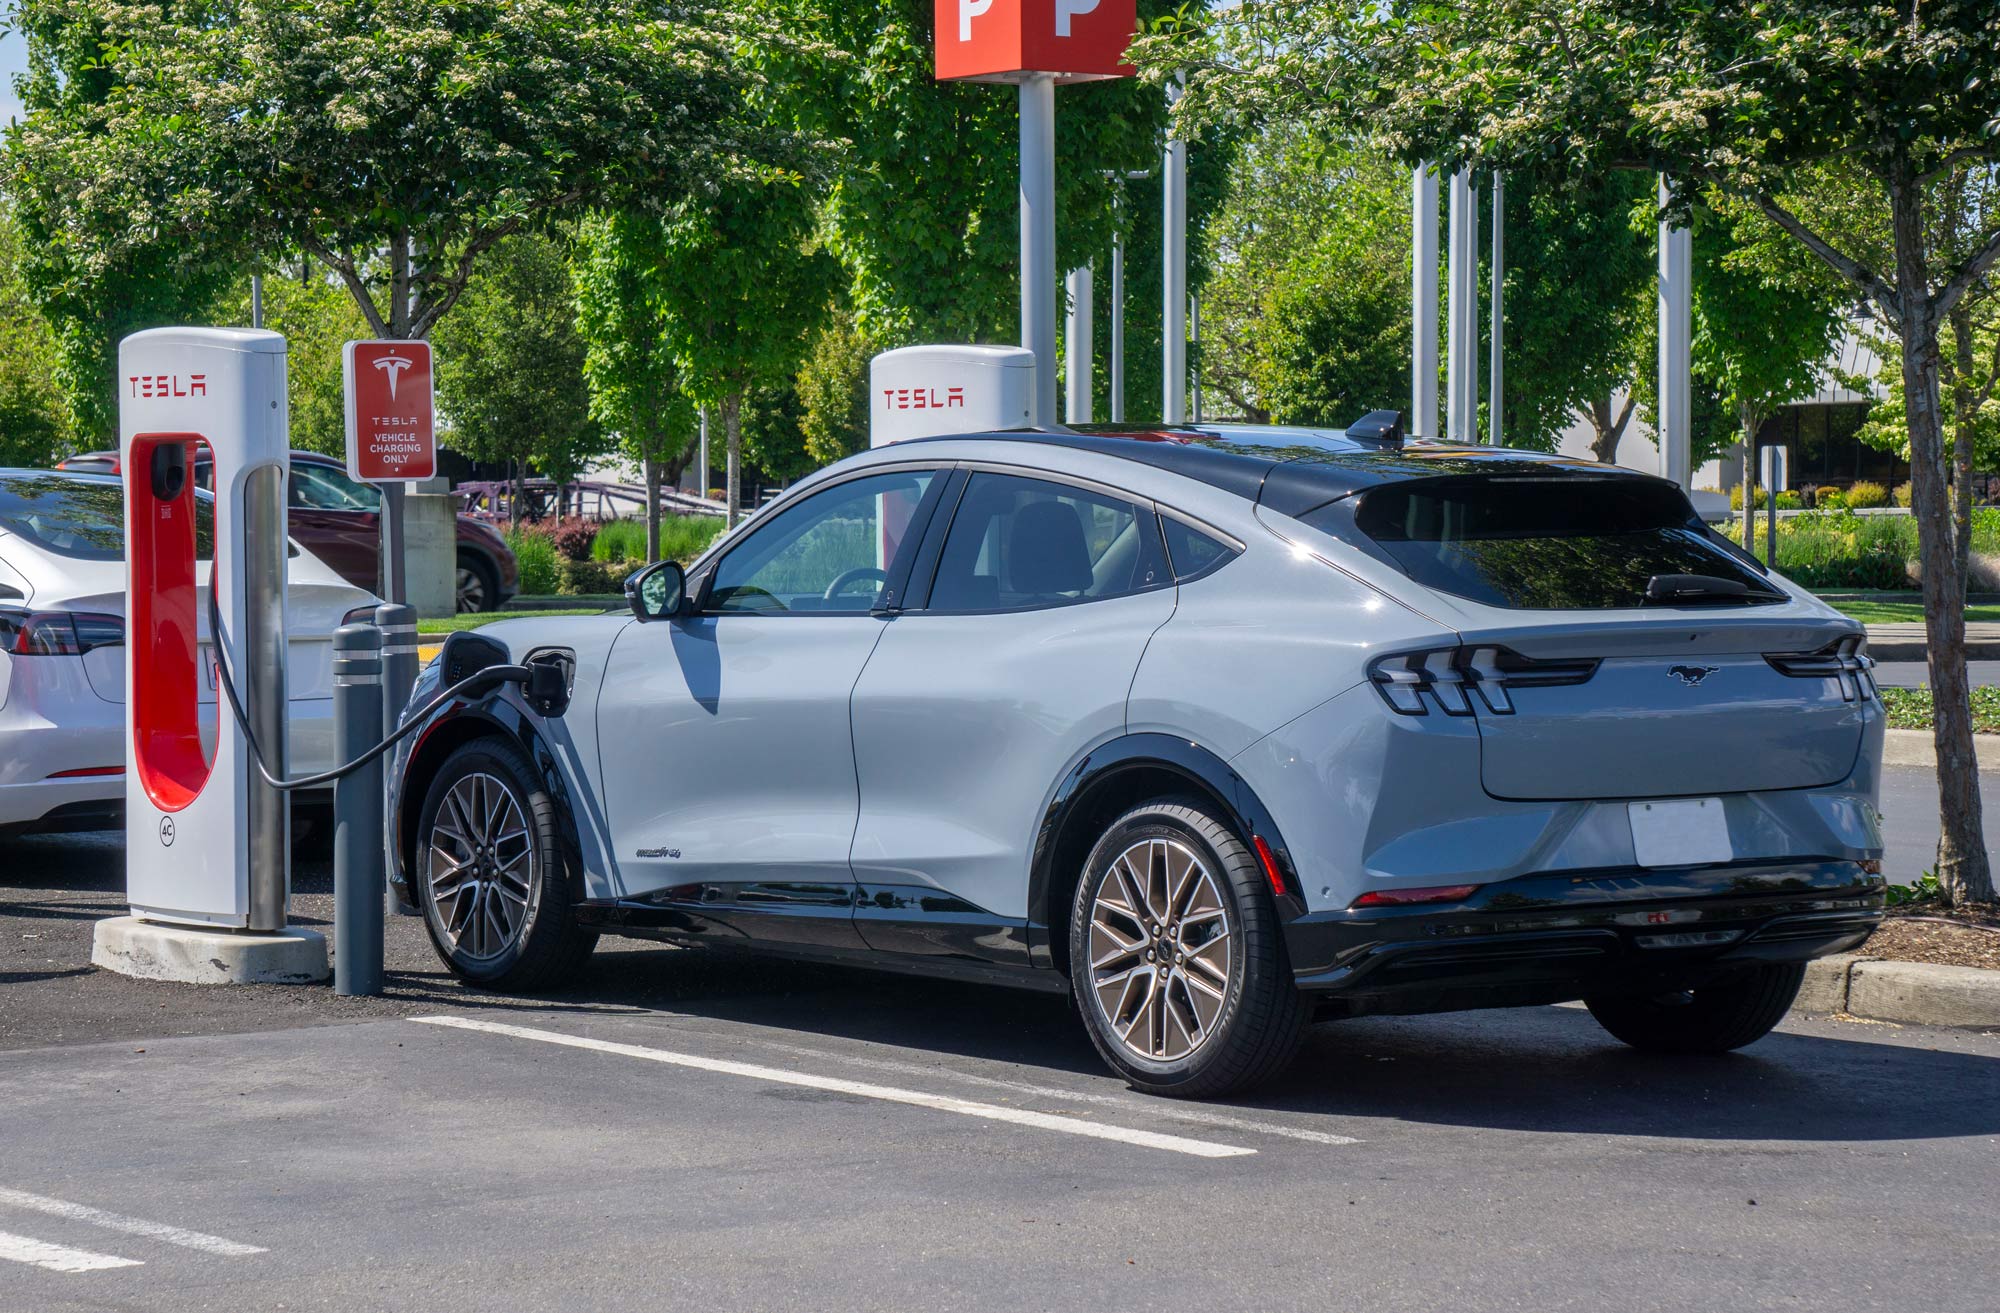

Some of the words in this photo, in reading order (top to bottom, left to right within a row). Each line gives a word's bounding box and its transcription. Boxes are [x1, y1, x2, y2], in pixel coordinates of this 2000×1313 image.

[129, 374, 206, 398] TESLA
[884, 388, 963, 409] TESLA
[371, 417, 418, 426] TESLA
[374, 433, 416, 442] VEHICLE
[369, 444, 422, 453] CHARGING
[382, 454, 409, 463] ONLY
[162, 825, 172, 836] 4C
